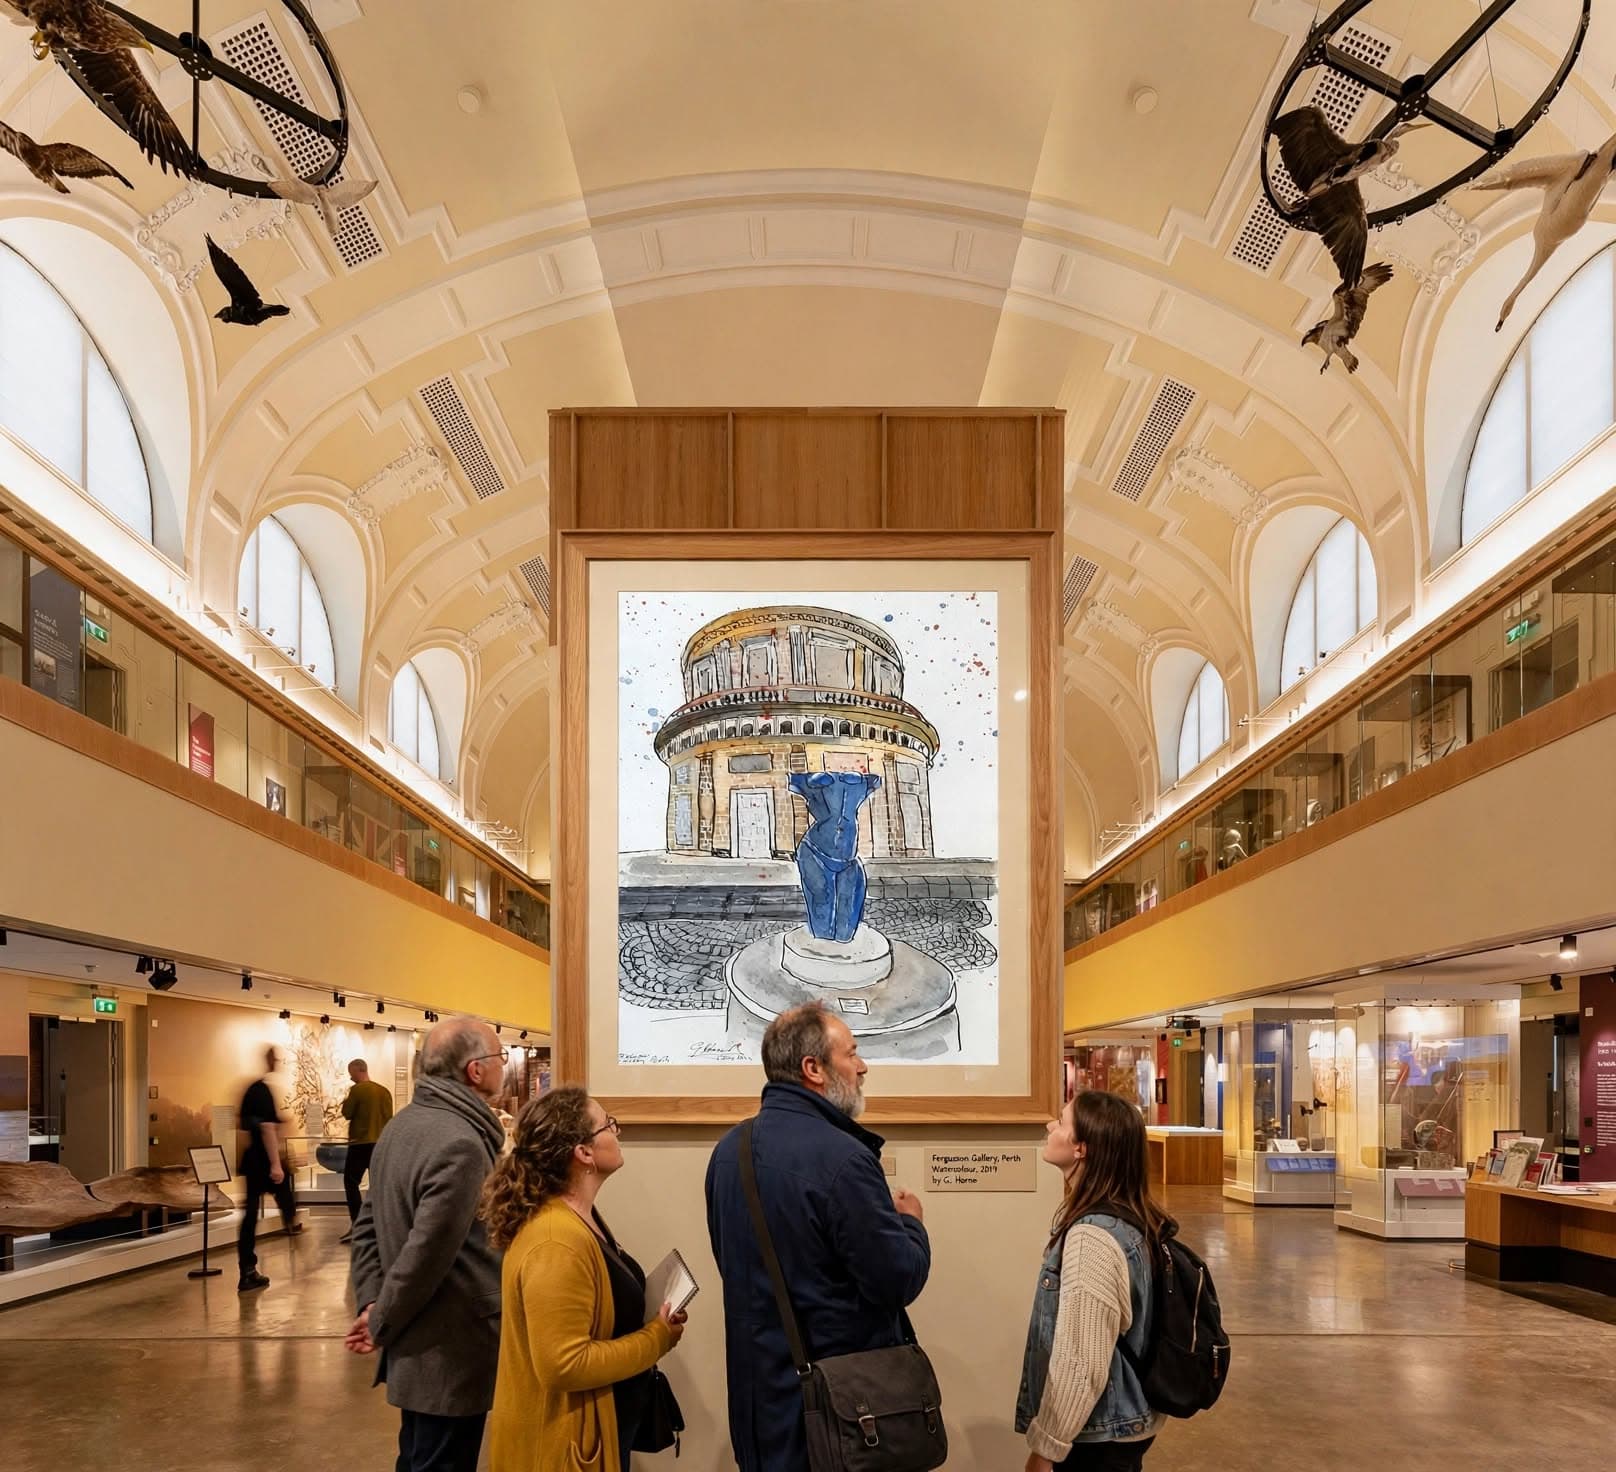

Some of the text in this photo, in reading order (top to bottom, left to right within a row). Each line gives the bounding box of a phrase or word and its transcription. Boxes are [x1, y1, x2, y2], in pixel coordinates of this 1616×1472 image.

[971, 1153, 1000, 1165] Gallery,
[1001, 1154, 1021, 1162] Perth
[932, 1175, 978, 1186] by G. Horne
